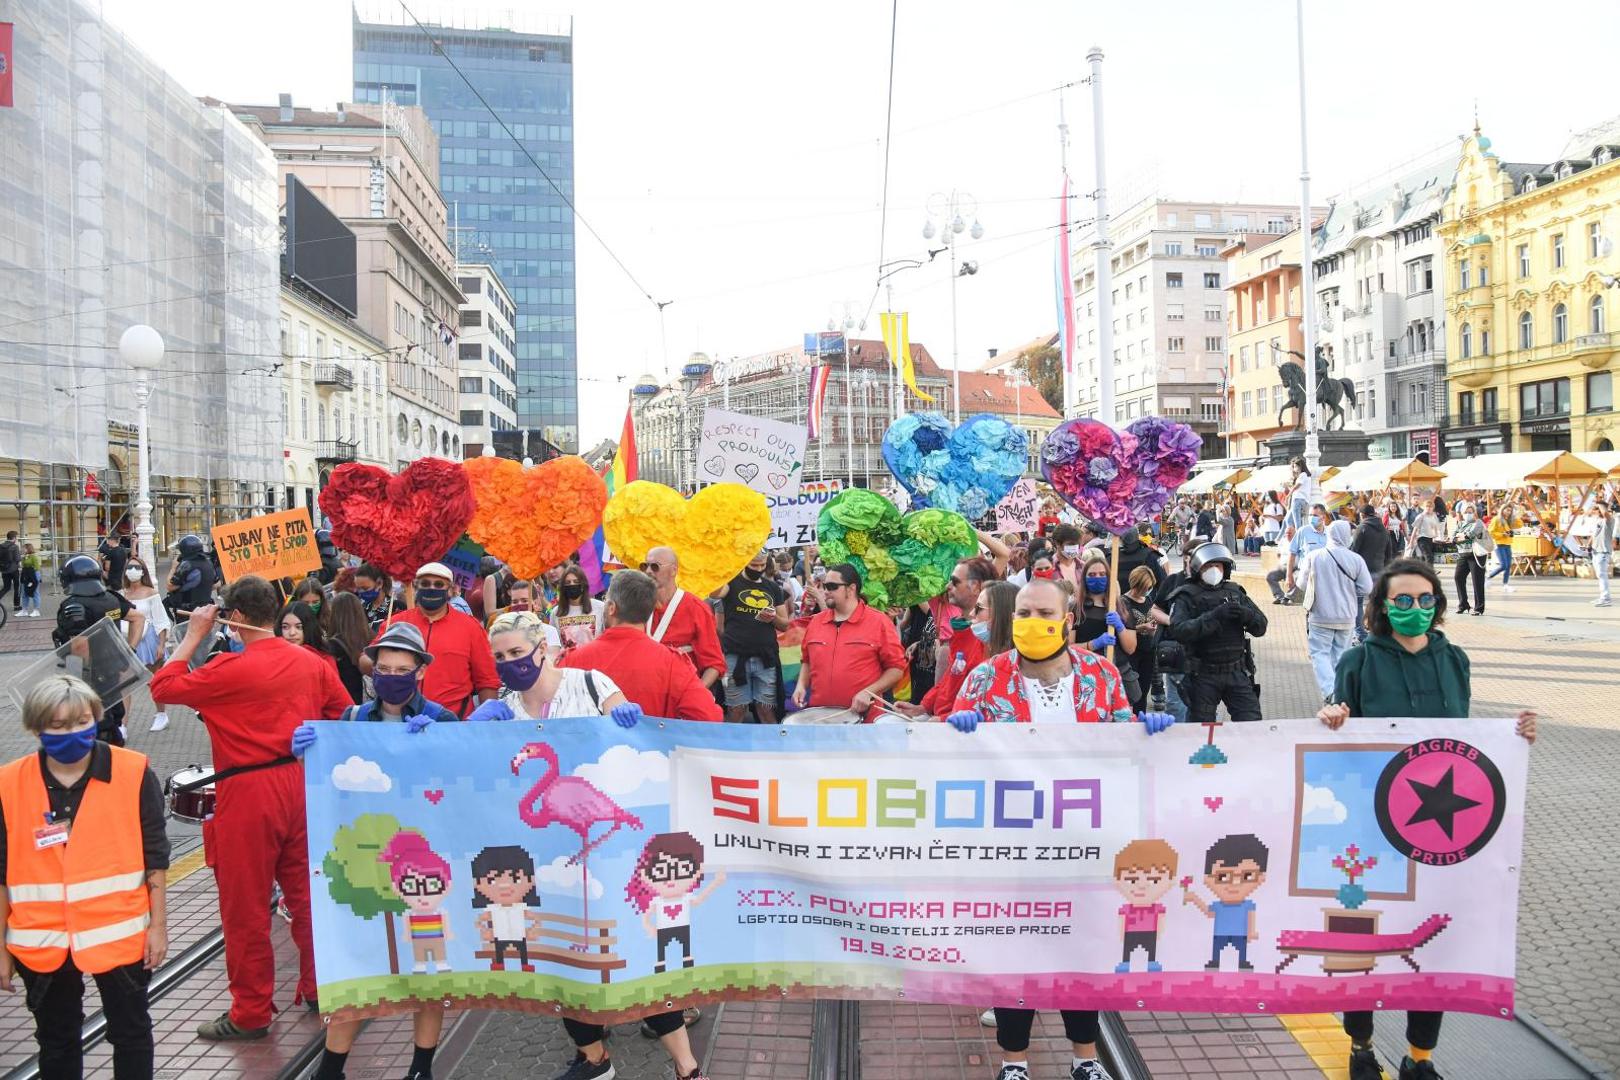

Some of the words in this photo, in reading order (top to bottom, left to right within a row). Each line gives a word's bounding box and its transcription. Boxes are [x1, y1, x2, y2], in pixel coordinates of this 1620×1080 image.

[704, 422, 760, 441] RESPECT
[767, 433, 800, 460] OUR
[219, 527, 263, 552] LJUBAV
[267, 524, 281, 540] NE
[285, 519, 308, 536] PITA
[254, 543, 266, 557] TI
[268, 540, 279, 554] JE
[282, 534, 308, 551] ISPOD
[795, 524, 817, 544] ZI
[1404, 739, 1480, 762] ZAGREB
[711, 775, 1101, 829] SLOBODA
[714, 833, 809, 859] UNUTAR
[817, 845, 831, 859] I
[839, 846, 921, 860] IZVAN
[928, 839, 1028, 860] ČETIRI
[1035, 846, 1101, 860] ZIDA
[1410, 848, 1468, 865] PRIDE
[737, 889, 802, 907] XIX.
[810, 894, 945, 919] POVORKA
[953, 901, 1072, 919] PONOSA
[737, 914, 798, 925] LGBTIQ
[802, 914, 853, 929] OSOBA
[856, 922, 866, 932] I
[869, 925, 950, 937] OBITELJI
[953, 926, 1016, 936] ZAGREB
[1019, 925, 1072, 935] PRIDE
[840, 936, 966, 964] 19.9.2020.
